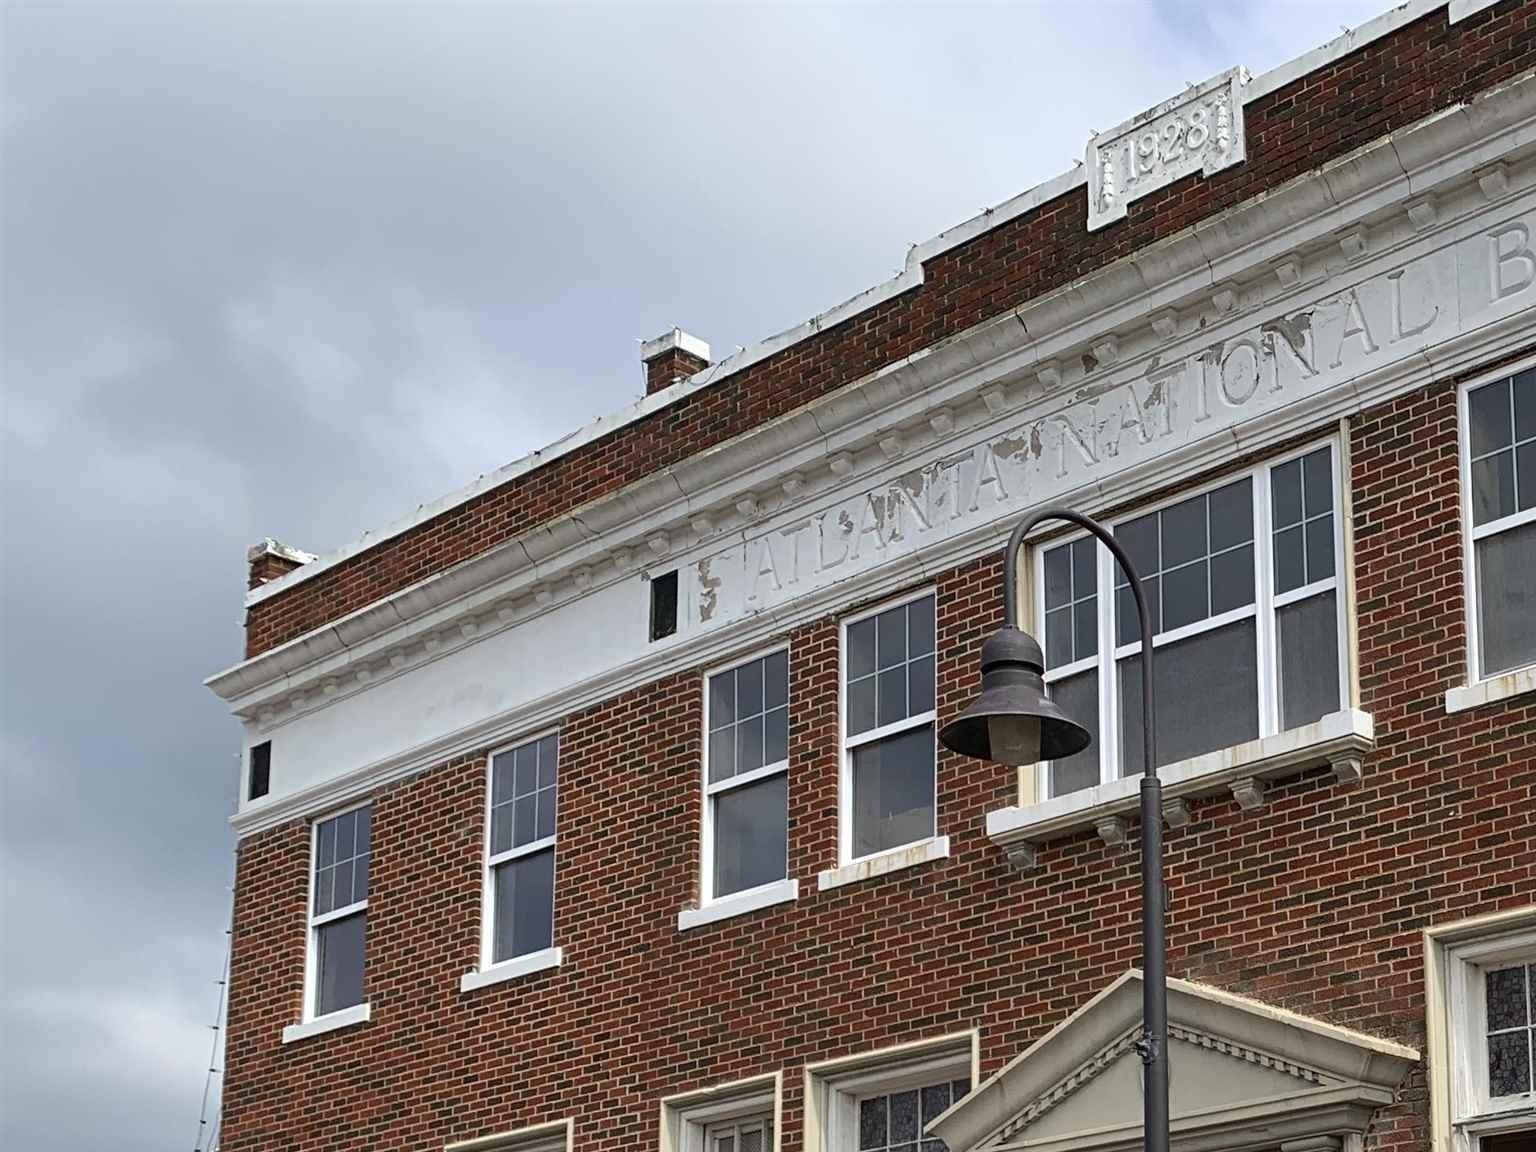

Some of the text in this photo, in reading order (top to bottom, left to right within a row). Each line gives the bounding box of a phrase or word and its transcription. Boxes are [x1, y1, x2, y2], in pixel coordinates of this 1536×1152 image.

[1125, 109, 1209, 183] 1928
[748, 442, 1009, 601] ATLANTA
[1048, 270, 1440, 480] NATIONAL
